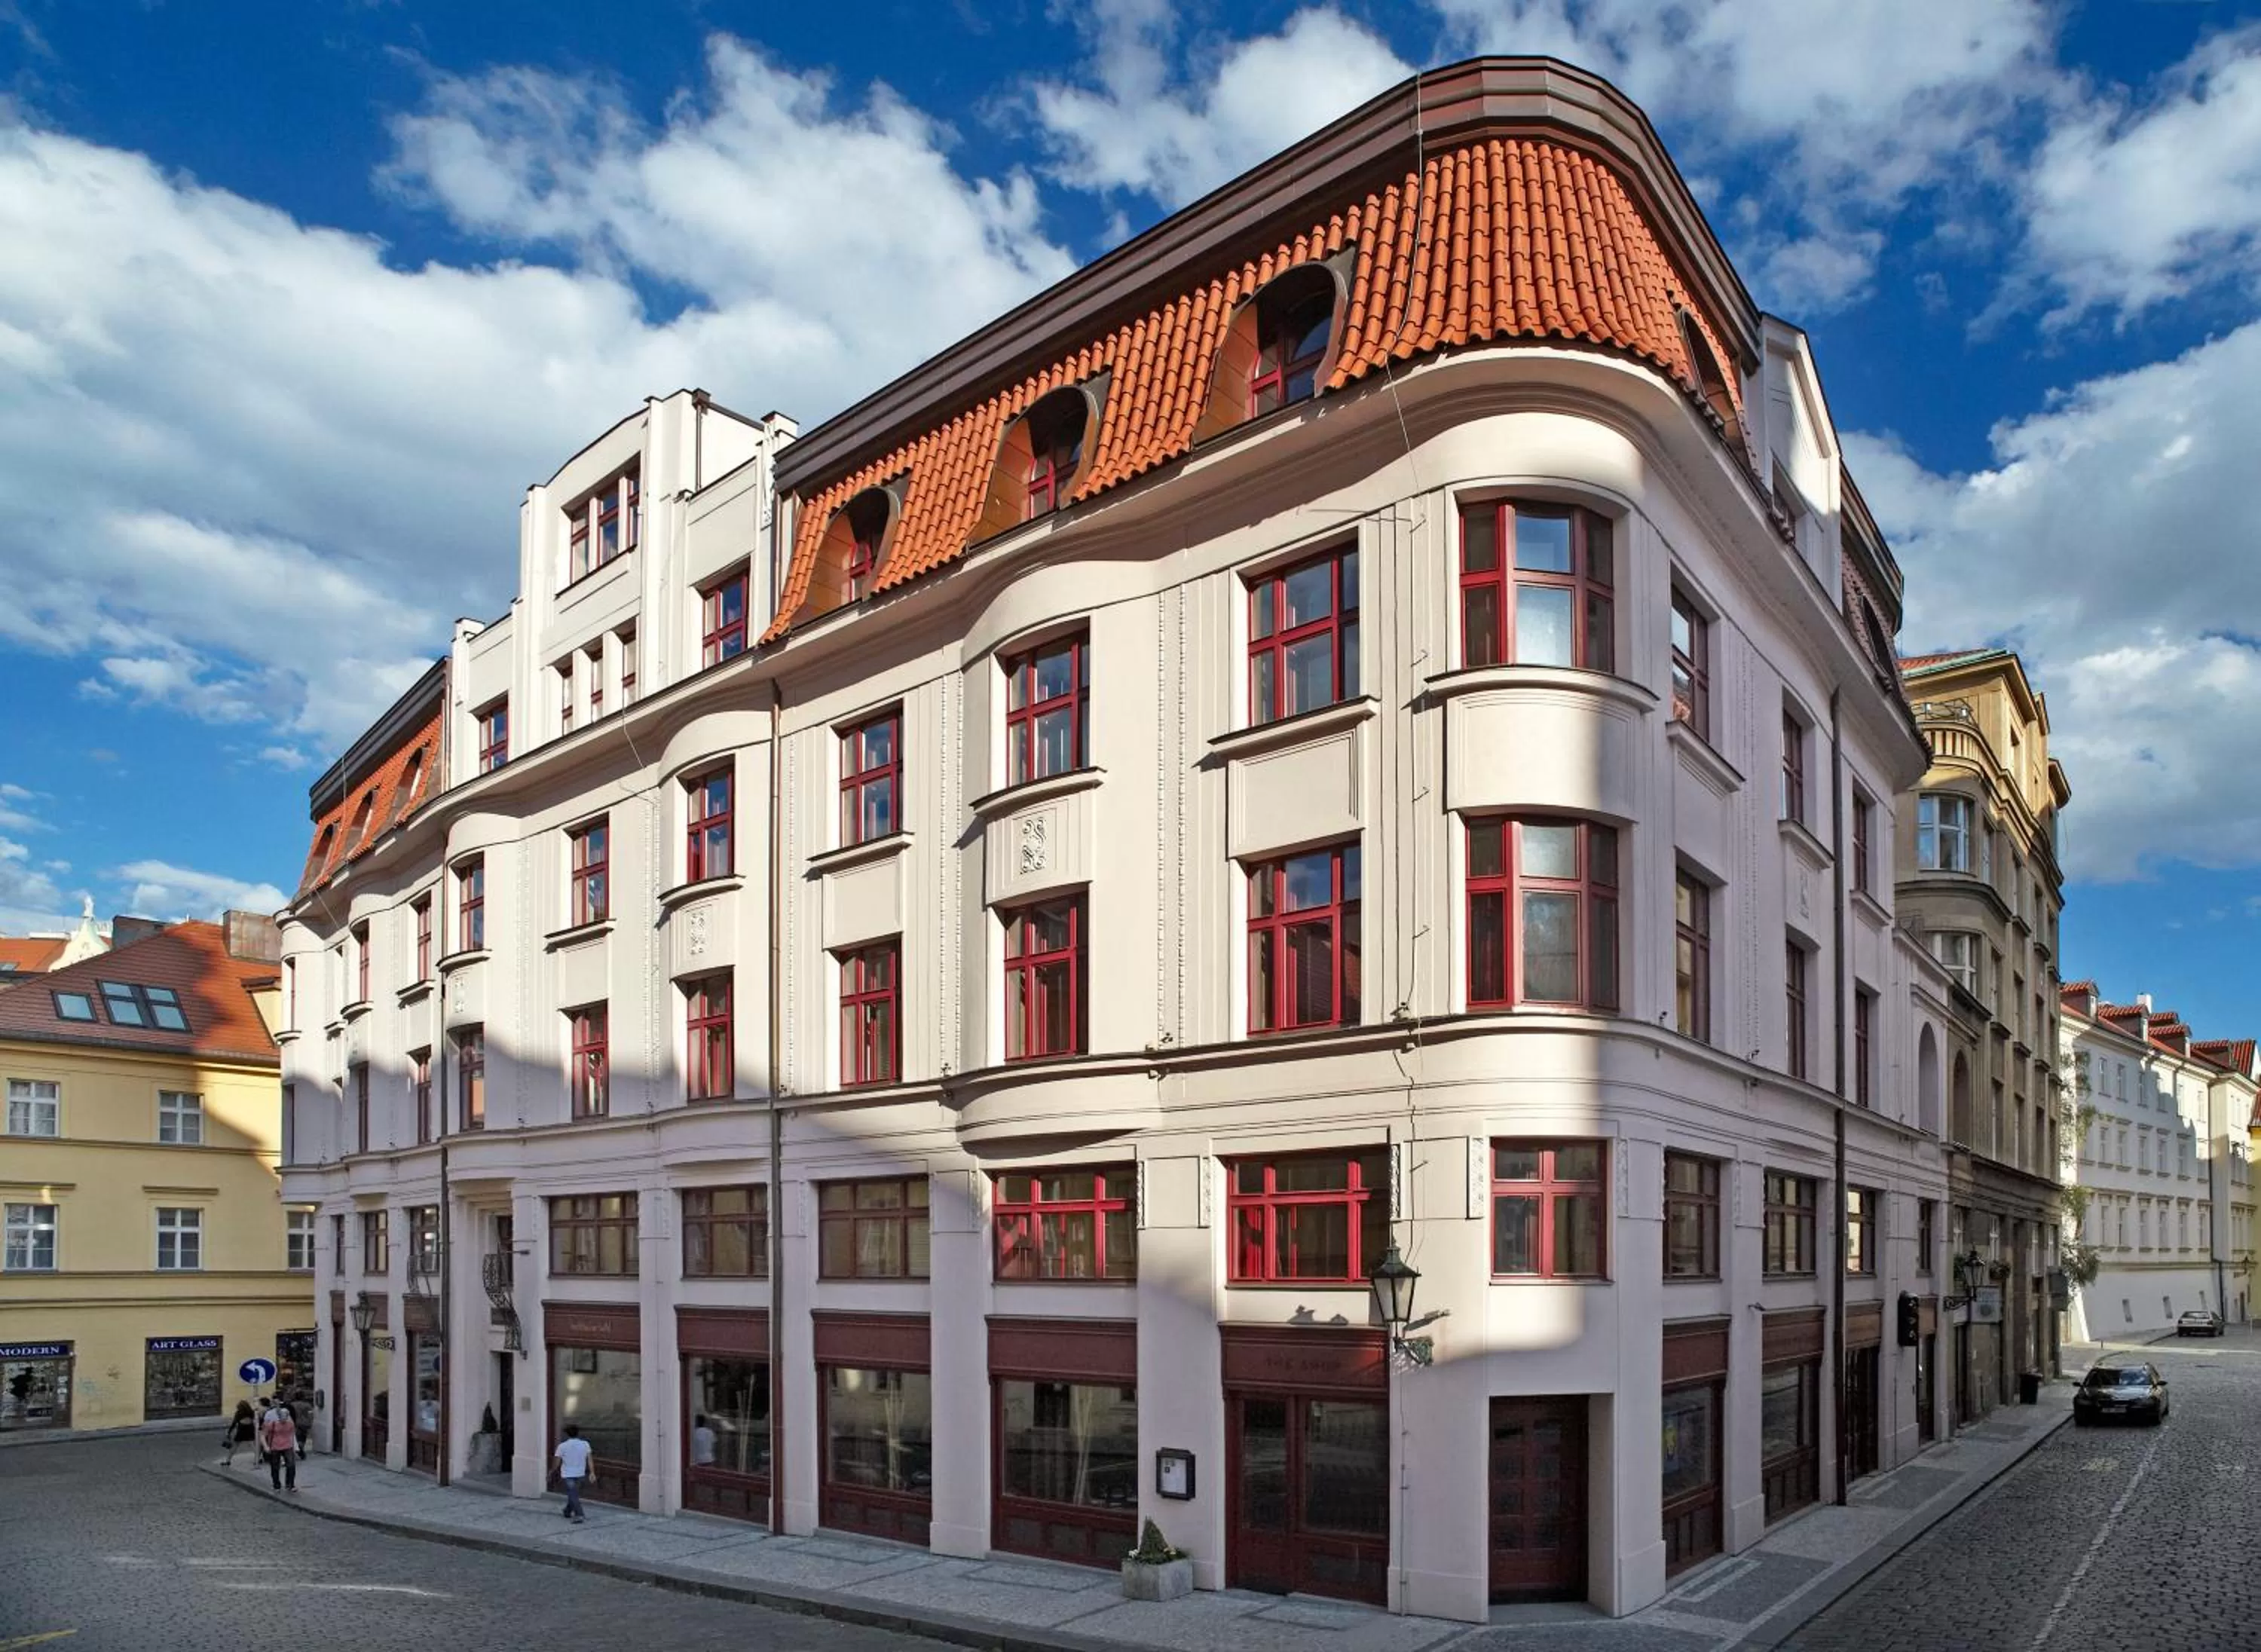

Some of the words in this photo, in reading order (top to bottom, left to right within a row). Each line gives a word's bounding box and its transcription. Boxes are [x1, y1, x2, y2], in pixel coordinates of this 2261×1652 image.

[152, 1341, 177, 1349] ART
[179, 1340, 217, 1348] GLASS
[0, 1346, 60, 1356] MODERN
